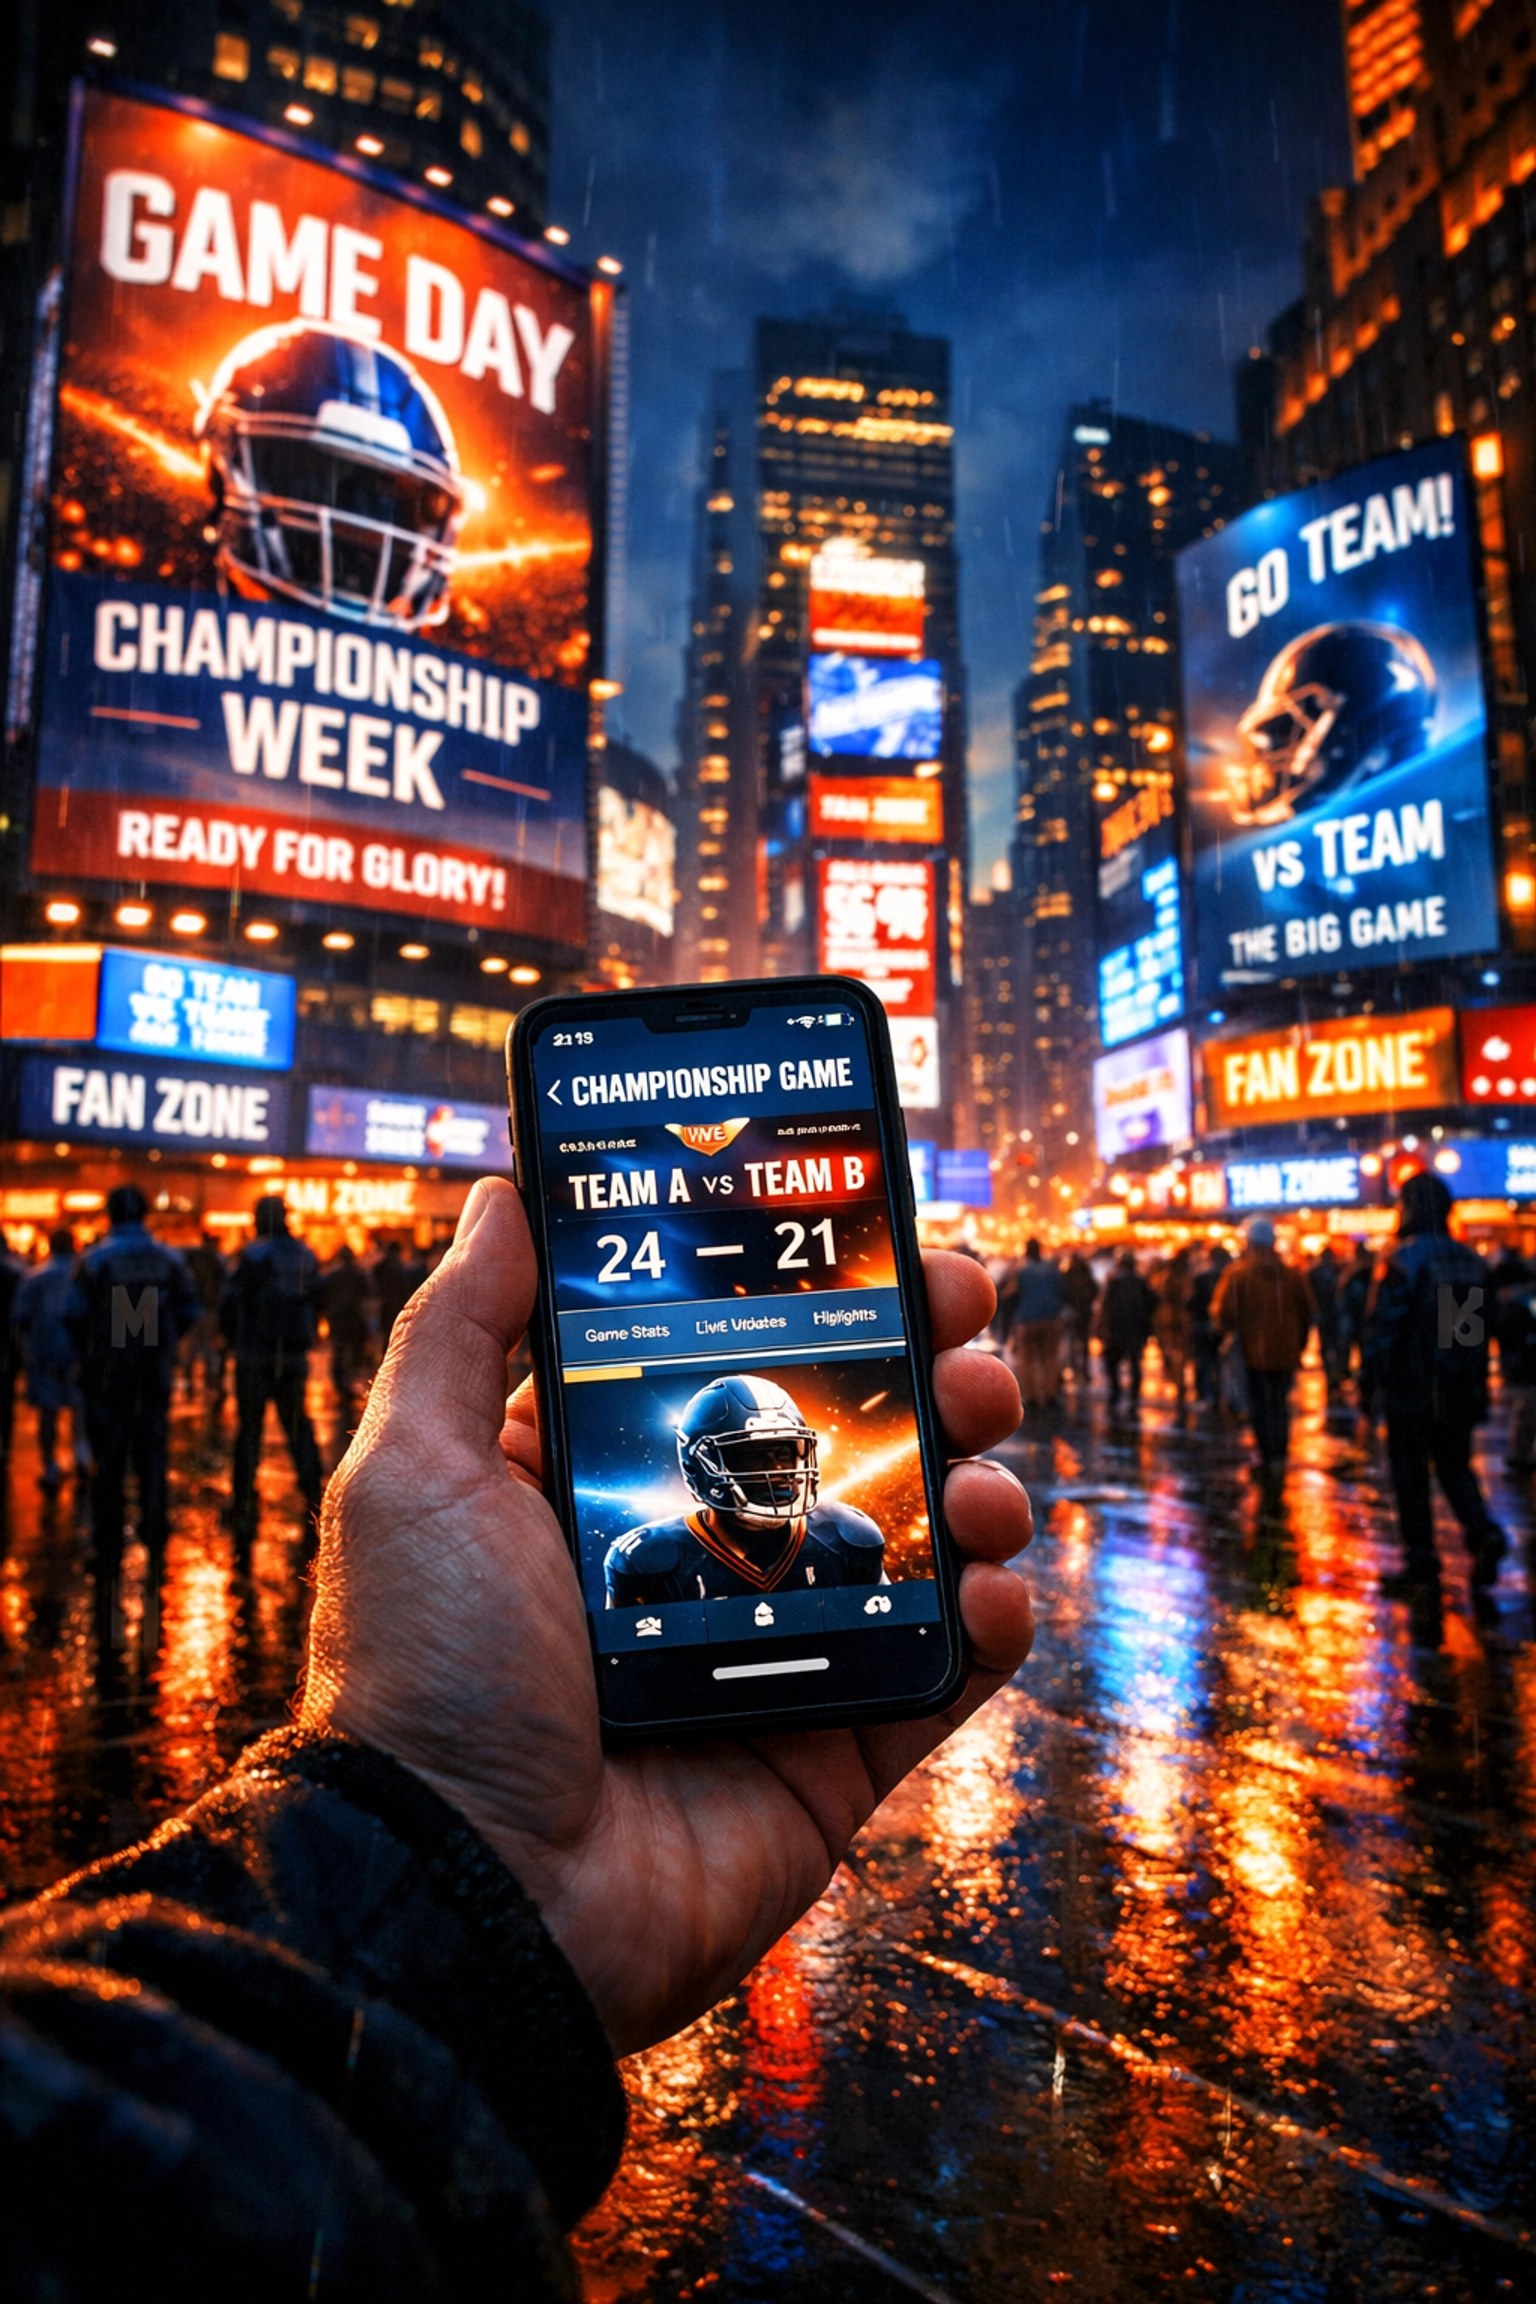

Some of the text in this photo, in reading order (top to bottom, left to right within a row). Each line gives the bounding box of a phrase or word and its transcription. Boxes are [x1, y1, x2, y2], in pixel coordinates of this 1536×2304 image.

[101, 169, 575, 416] GAME DAY
[1227, 473, 1455, 639] GO TEAM!
[94, 600, 541, 747] CHAMPIONSHIP
[221, 691, 446, 810] WEEK
[118, 809, 506, 911] READY FOR GLORY!
[1313, 798, 1445, 880] TEAM
[1229, 895, 1448, 968] THE BIG GAME
[52, 1066, 270, 1142] FAN ZONE
[571, 1058, 853, 1106] CHAMPIONSHIP GAME
[1225, 1046, 1300, 1107] FAN
[1306, 1031, 1427, 1097] ZONE
[568, 1168, 659, 1210] TEAM
[669, 1168, 691, 1203] A
[744, 1160, 833, 1197] TEAM
[843, 1156, 866, 1191] B
[596, 1231, 666, 1284] 24
[773, 1217, 838, 1270] 21
[585, 1325, 671, 1343] Game Stats
